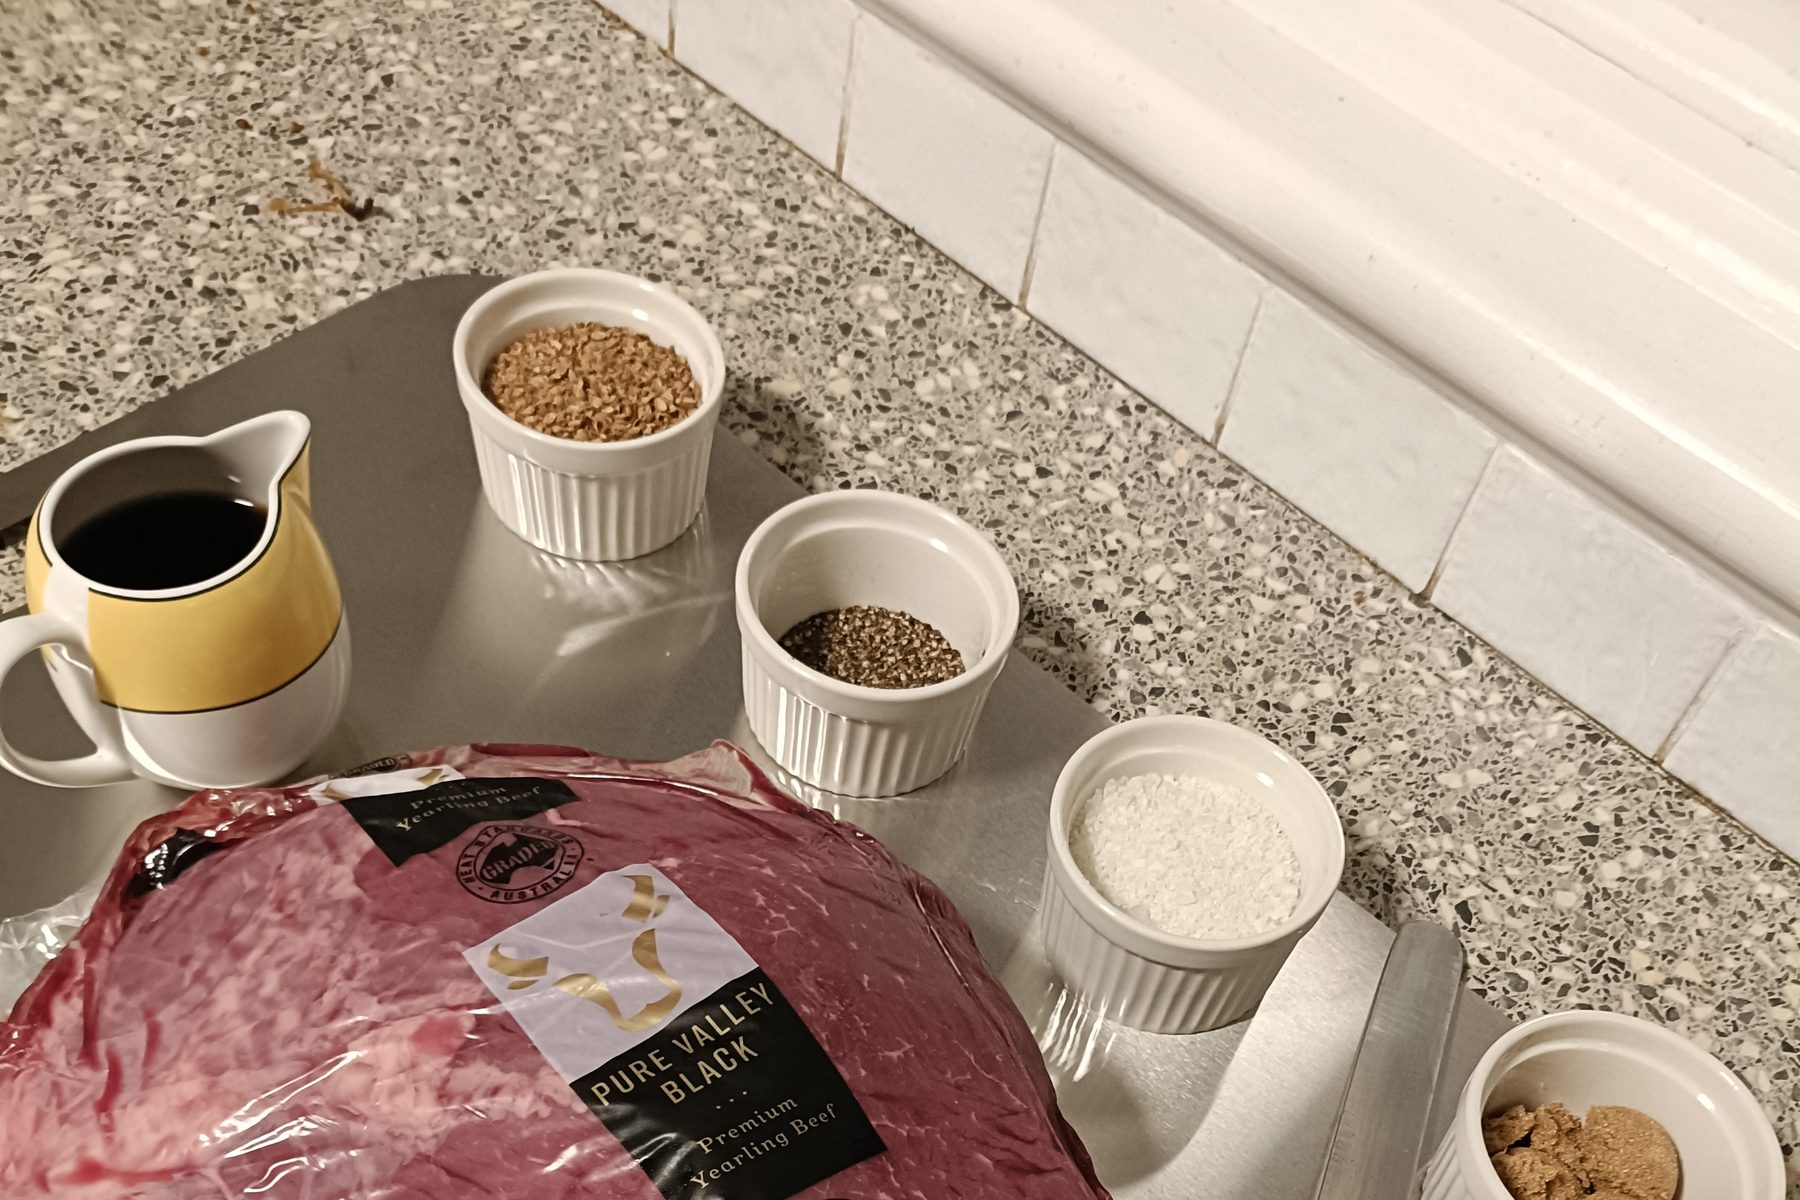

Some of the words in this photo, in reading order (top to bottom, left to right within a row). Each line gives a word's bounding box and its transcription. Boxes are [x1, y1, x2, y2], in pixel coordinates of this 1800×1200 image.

[396, 801, 489, 832] Yearling
[495, 786, 540, 804] Beef
[411, 786, 507, 809] Premium
[482, 841, 555, 880] GRADED
[590, 1049, 673, 1106] PURE
[671, 982, 774, 1054] VALLEY
[660, 1036, 759, 1104] BLACK
[690, 1131, 789, 1189] Yearling
[790, 1103, 838, 1137] Beef
[696, 1098, 798, 1154] Premium
